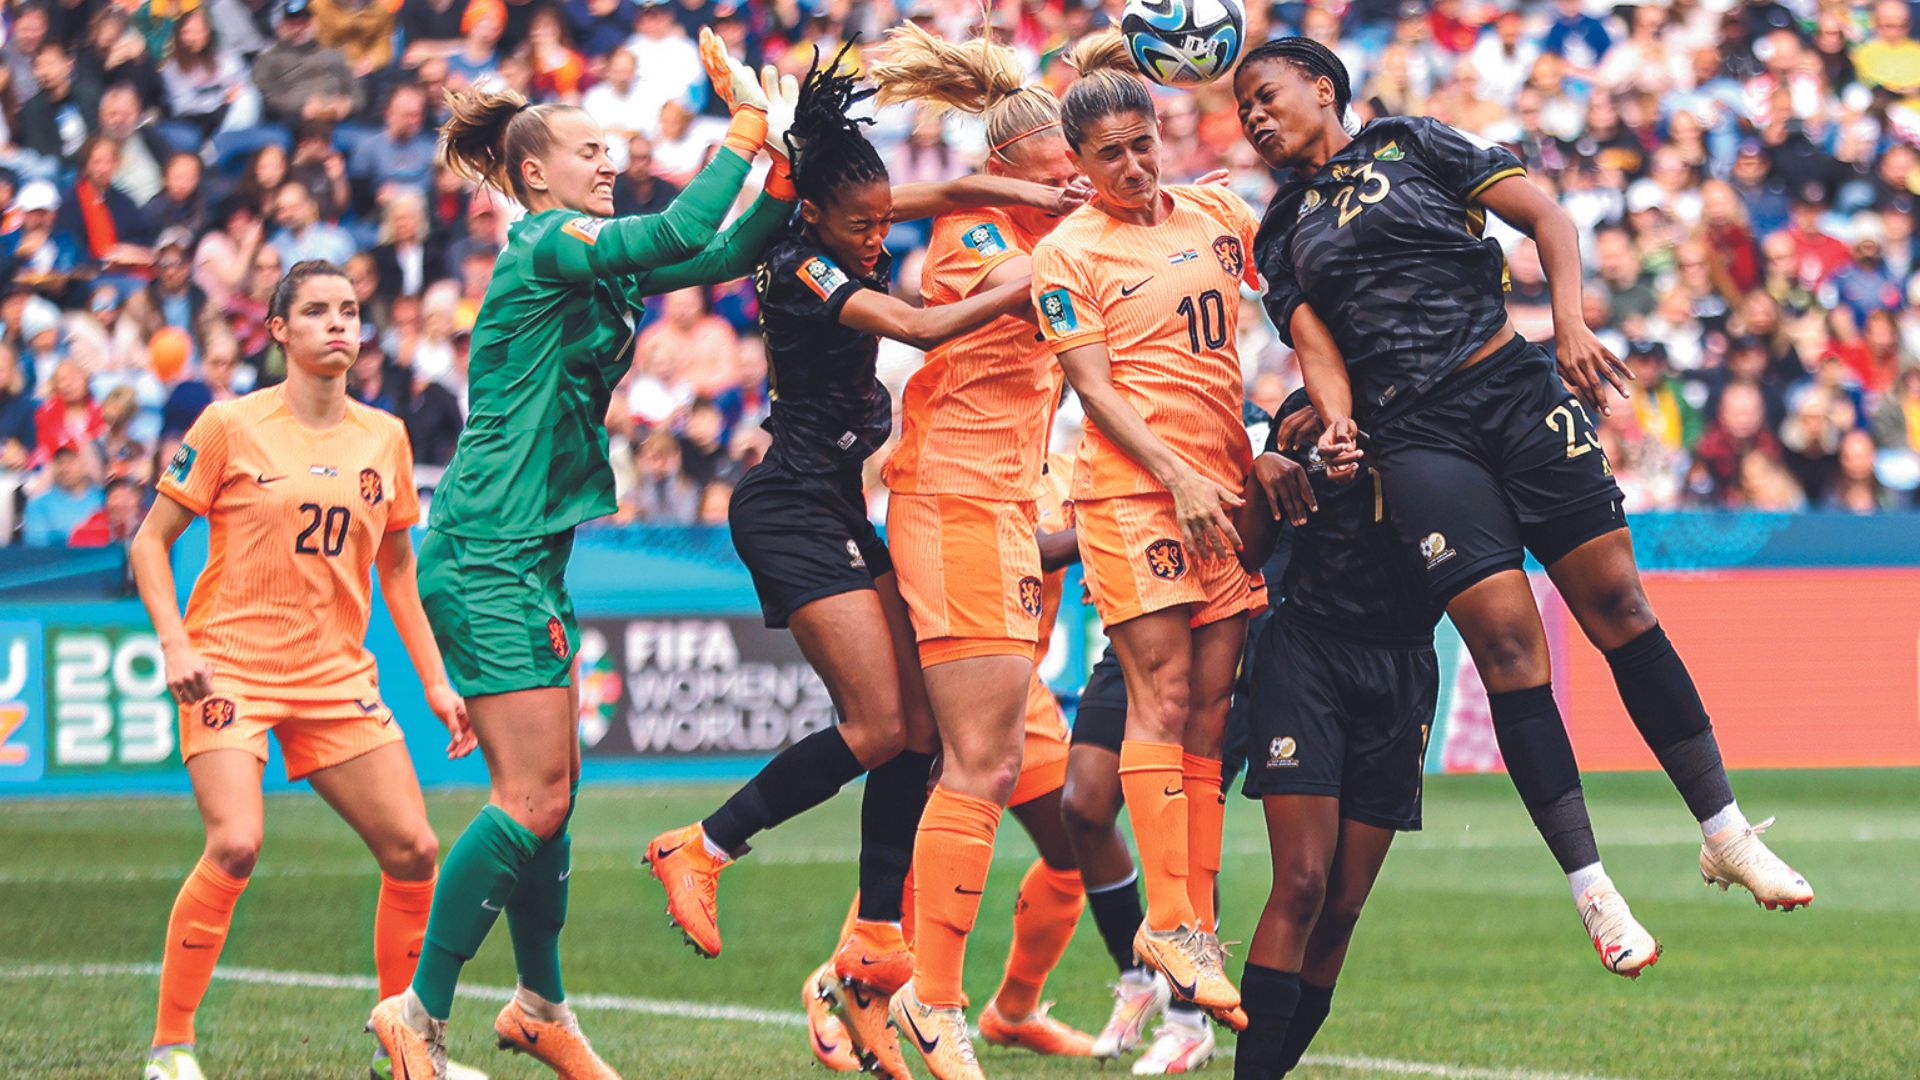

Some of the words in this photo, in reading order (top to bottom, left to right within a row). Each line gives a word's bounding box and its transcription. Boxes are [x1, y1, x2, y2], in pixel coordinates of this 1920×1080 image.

[1332, 161, 1391, 229] 23
[1176, 289, 1227, 354] 10
[295, 502, 351, 557] 20
[55, 633, 167, 699] 20
[626, 620, 739, 672] FIFA
[55, 701, 176, 765] 23
[627, 702, 788, 752] WORLD
